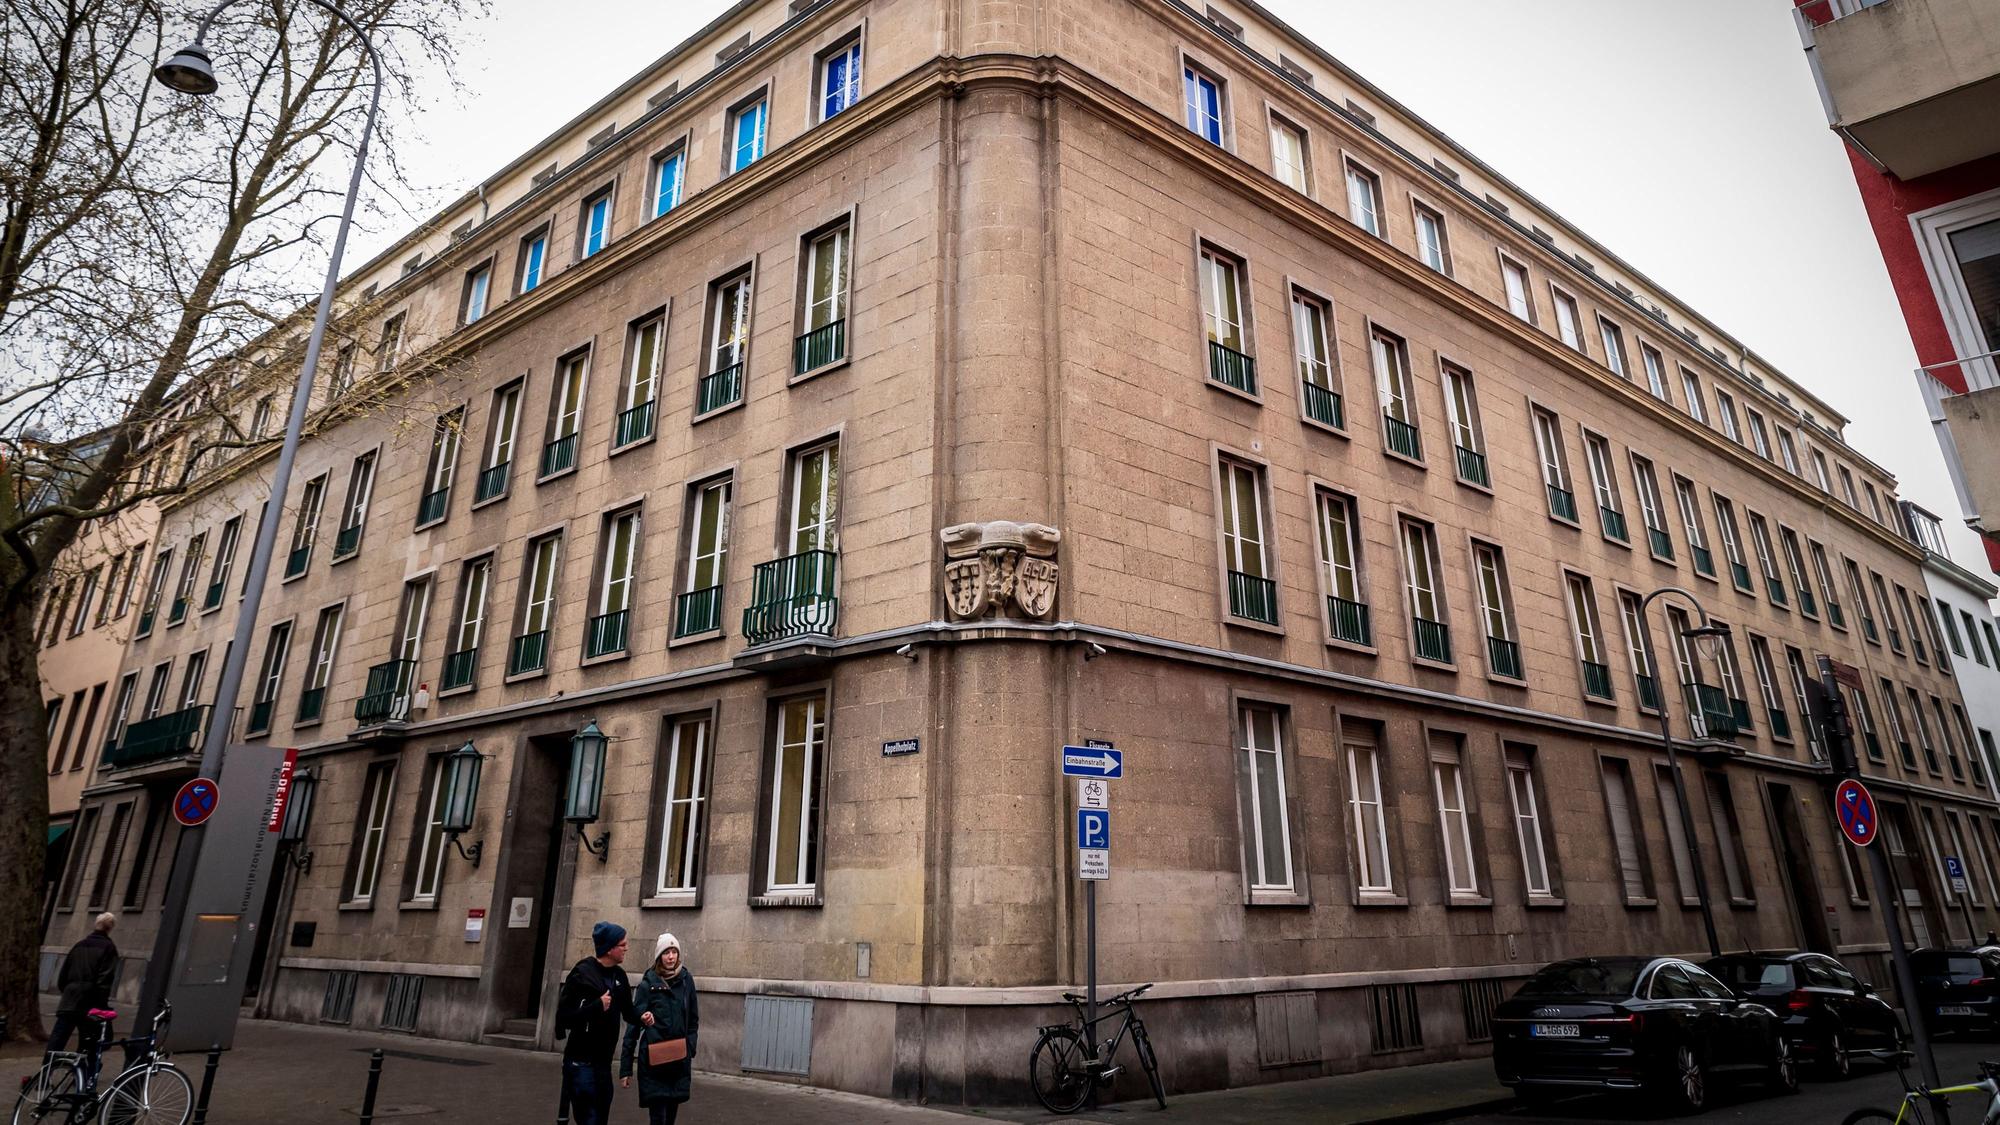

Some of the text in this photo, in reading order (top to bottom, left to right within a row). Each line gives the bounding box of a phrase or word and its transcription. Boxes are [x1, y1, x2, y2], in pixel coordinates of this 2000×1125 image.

[1066, 757, 1105, 766] Einbahnstraße
[1085, 815, 1102, 846] P
[241, 767, 281, 912] Köln im Nationalsozialismus
[1948, 860, 1956, 874] P
[1563, 1025, 1579, 1035] 692
